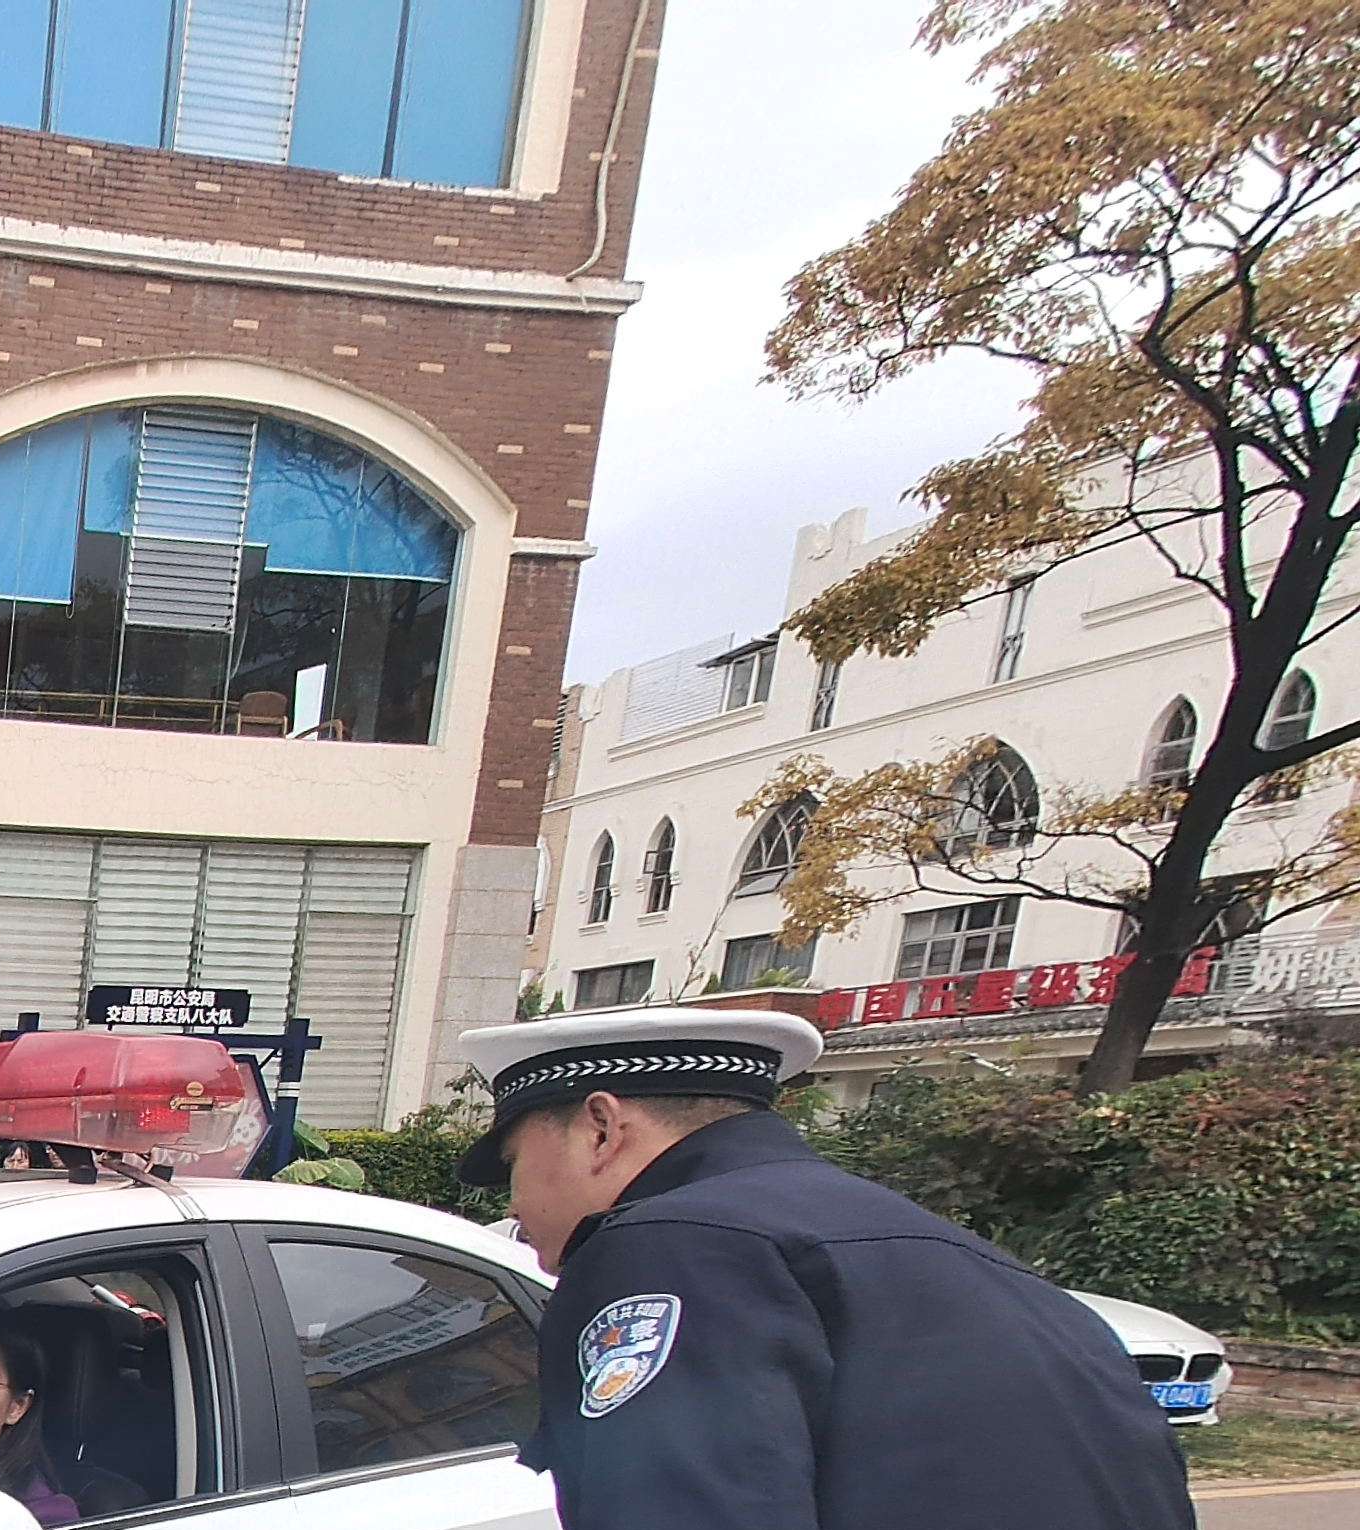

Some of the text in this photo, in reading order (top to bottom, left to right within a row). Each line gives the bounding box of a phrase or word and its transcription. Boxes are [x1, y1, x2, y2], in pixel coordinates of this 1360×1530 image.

[129, 988, 216, 1007] 昆明市公安局
[105, 1004, 234, 1025] 交通警察支队八大队
